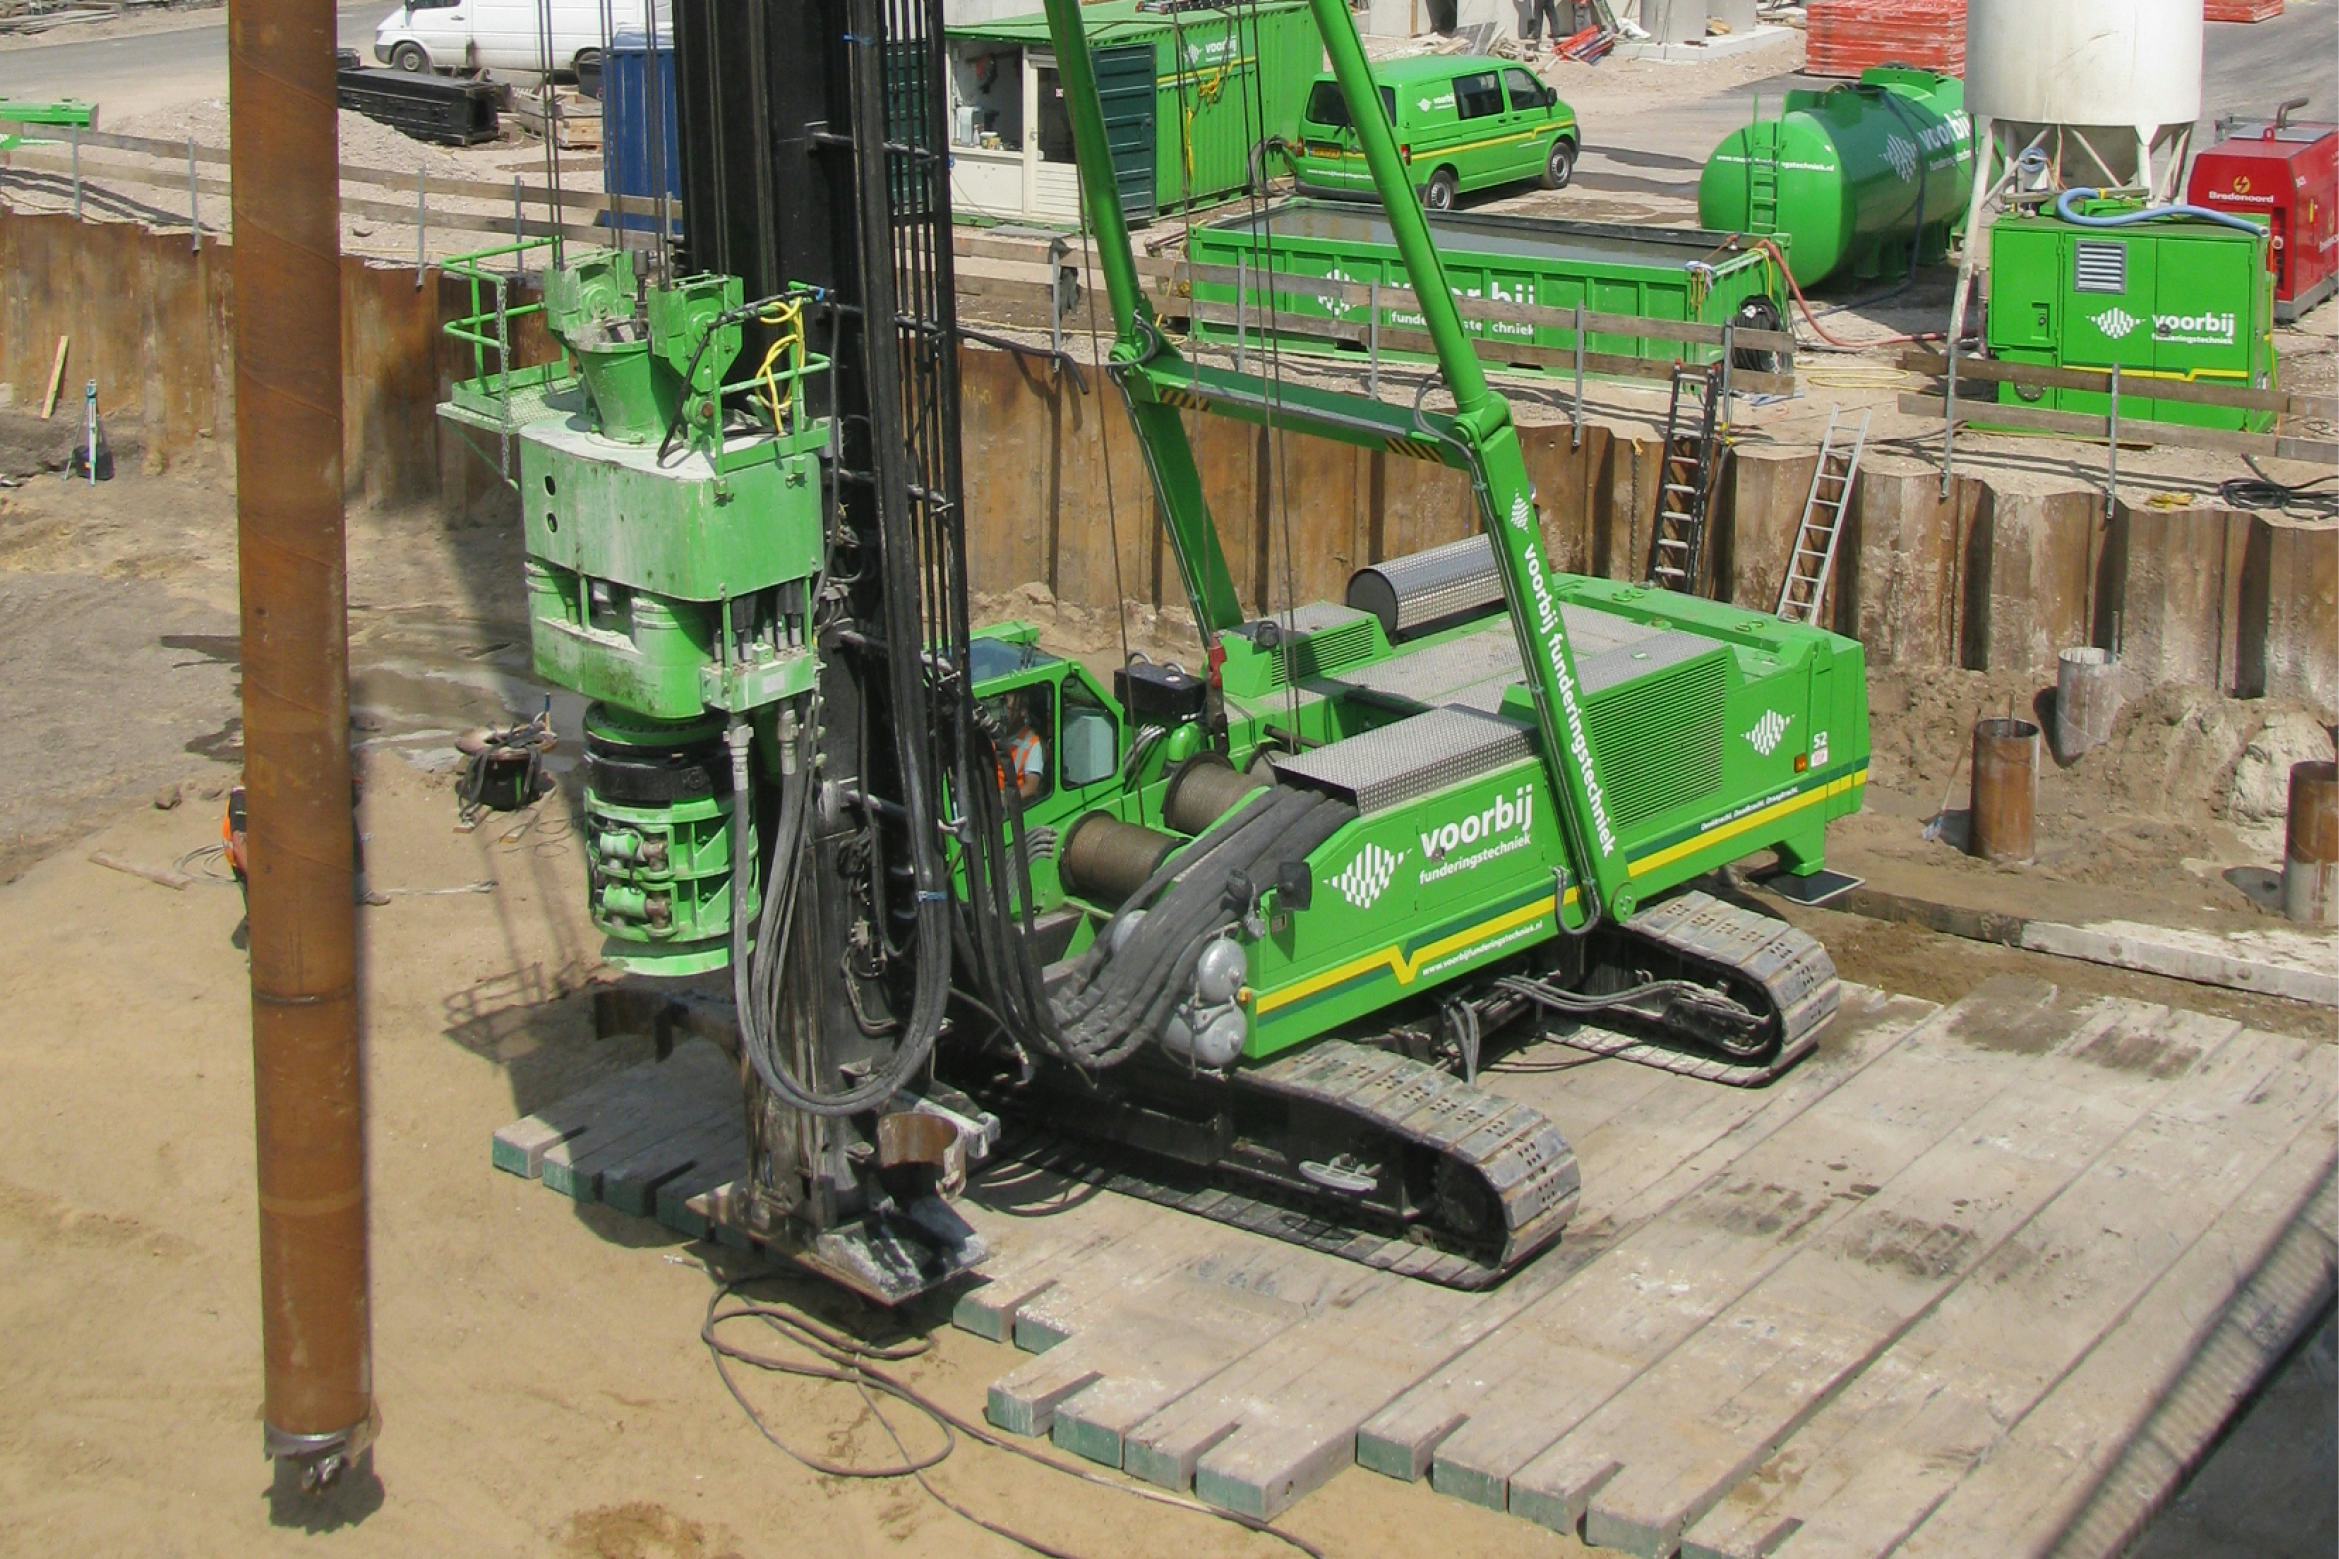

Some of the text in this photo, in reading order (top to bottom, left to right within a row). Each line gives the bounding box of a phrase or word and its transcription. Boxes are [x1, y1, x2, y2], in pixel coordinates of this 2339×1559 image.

[2208, 190, 2274, 203] Bredenoord
[2152, 312, 2235, 337] voorbij
[1524, 543, 1616, 858] voorbij funderingstechniek
[1420, 783, 1533, 858] voorbij
[1419, 833, 1532, 885] funderingstechniek
